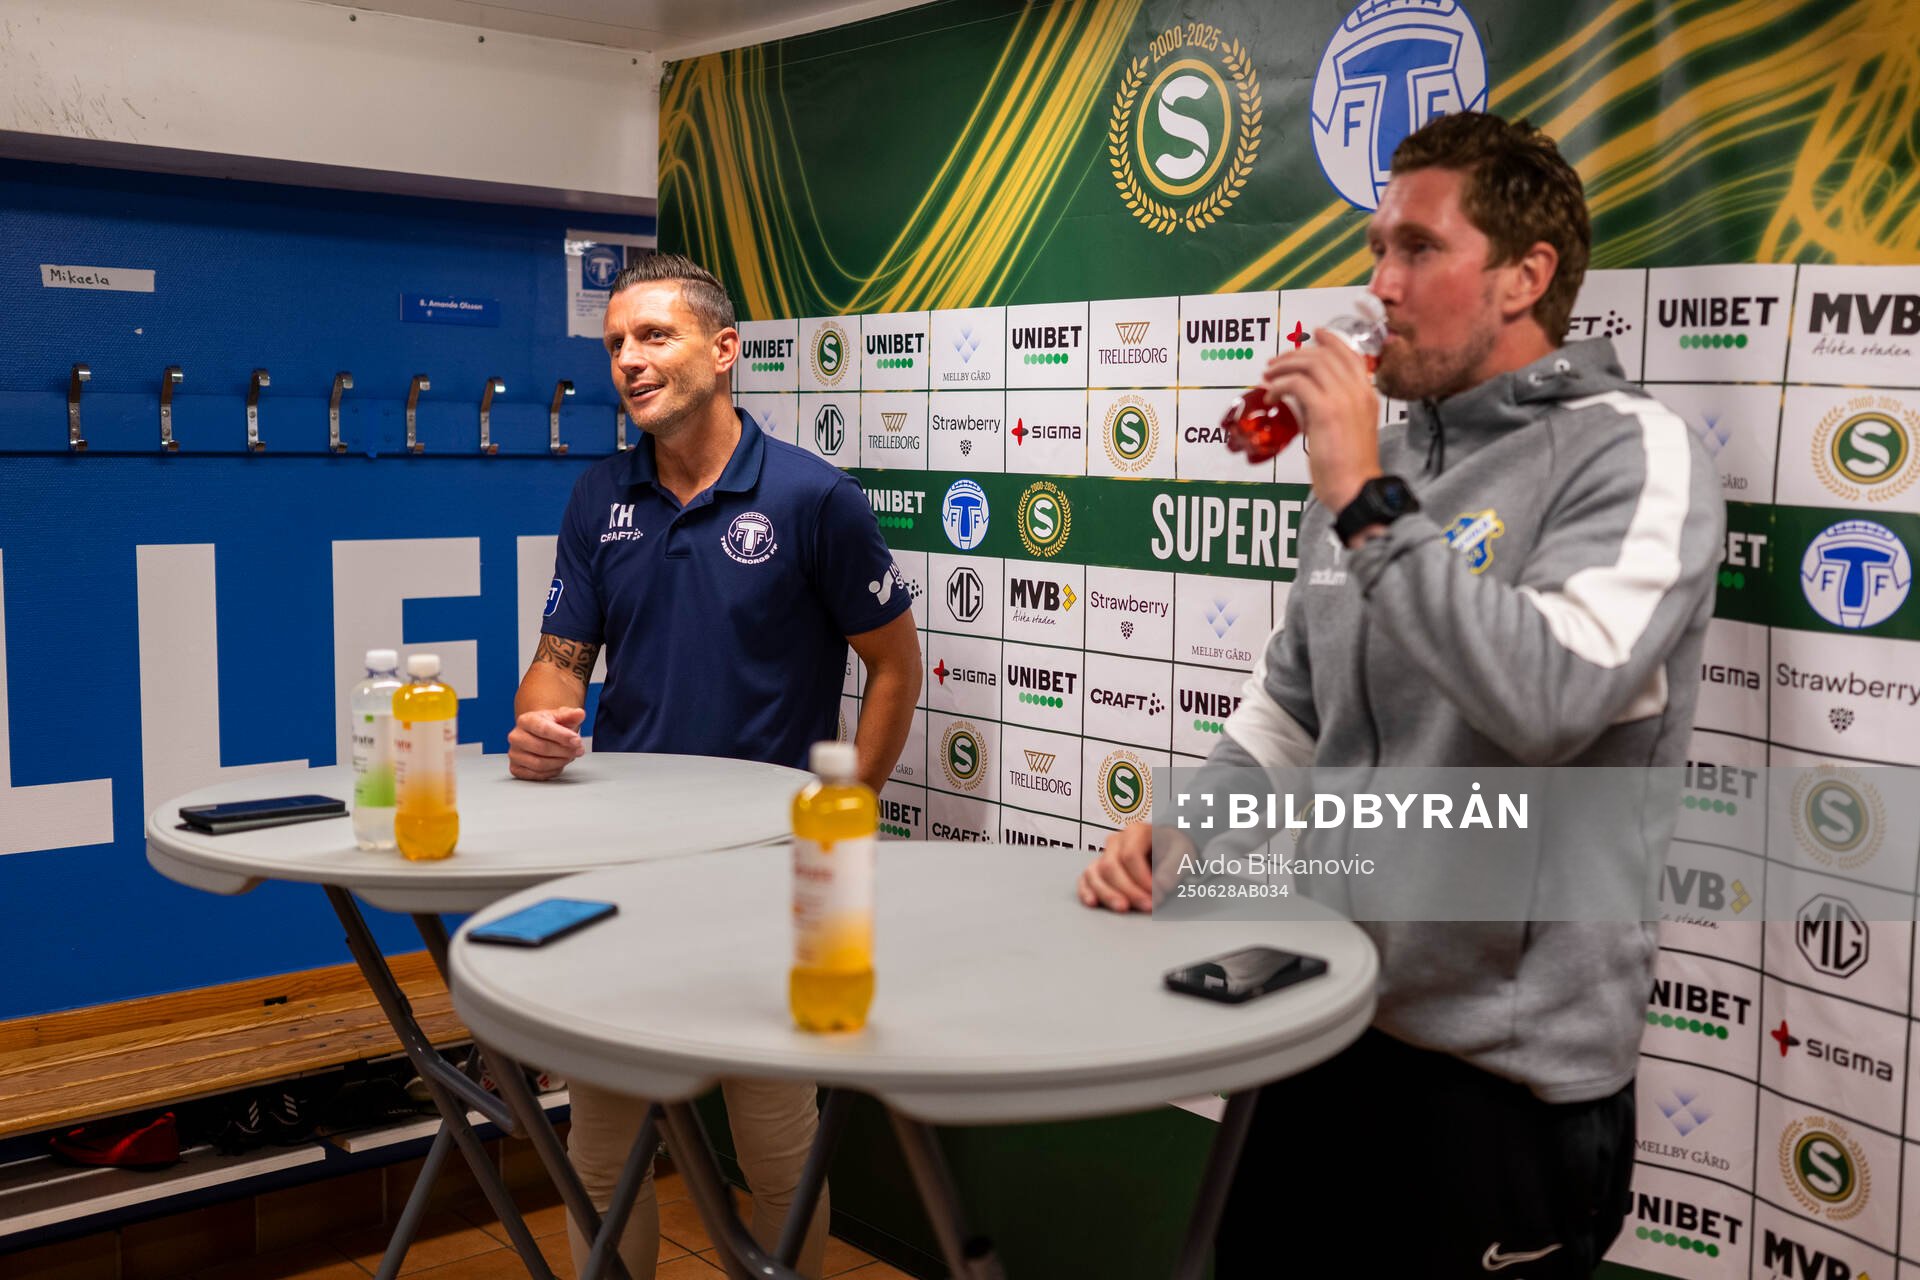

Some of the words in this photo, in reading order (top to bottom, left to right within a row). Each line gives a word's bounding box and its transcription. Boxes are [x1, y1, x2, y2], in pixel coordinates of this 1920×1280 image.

[1149, 23, 1222, 63] 2000-2025
[50, 268, 109, 285] Mikaela
[1658, 297, 1779, 328] UNIBET
[1809, 292, 1920, 336] MVB
[1012, 326, 1082, 350] UNIBET
[1186, 317, 1270, 344] UNIBET
[742, 339, 794, 359] UNIBET
[866, 333, 924, 355] UNIBET
[1099, 347, 1168, 365] TRELLEBORG
[943, 371, 969, 382] MELLBY
[971, 370, 990, 381] GÅRD
[932, 415, 1001, 434] Strawberry
[868, 434, 920, 450] TRELLEBORG
[609, 502, 636, 529] KH
[600, 531, 633, 543] CRAFT
[1151, 493, 1304, 569] SUPERE
[720, 535, 770, 565] TRELLEBORGS
[1010, 578, 1060, 611] MVB
[1090, 591, 1169, 617] Strawberry
[1191, 645, 1224, 659] MELLBY
[1225, 647, 1252, 662] GÅRD
[1008, 664, 1077, 695] UNIBET
[1775, 663, 1920, 706] Strawberry
[1090, 688, 1147, 711] CRAFT
[895, 763, 914, 776] GÅRD
[1684, 761, 1758, 799] IBET
[1010, 770, 1072, 797] TRELLEBORG
[879, 799, 921, 827] IBET
[1648, 979, 1751, 1025] NIBET
[1691, 1151, 1730, 1171] GÅRD
